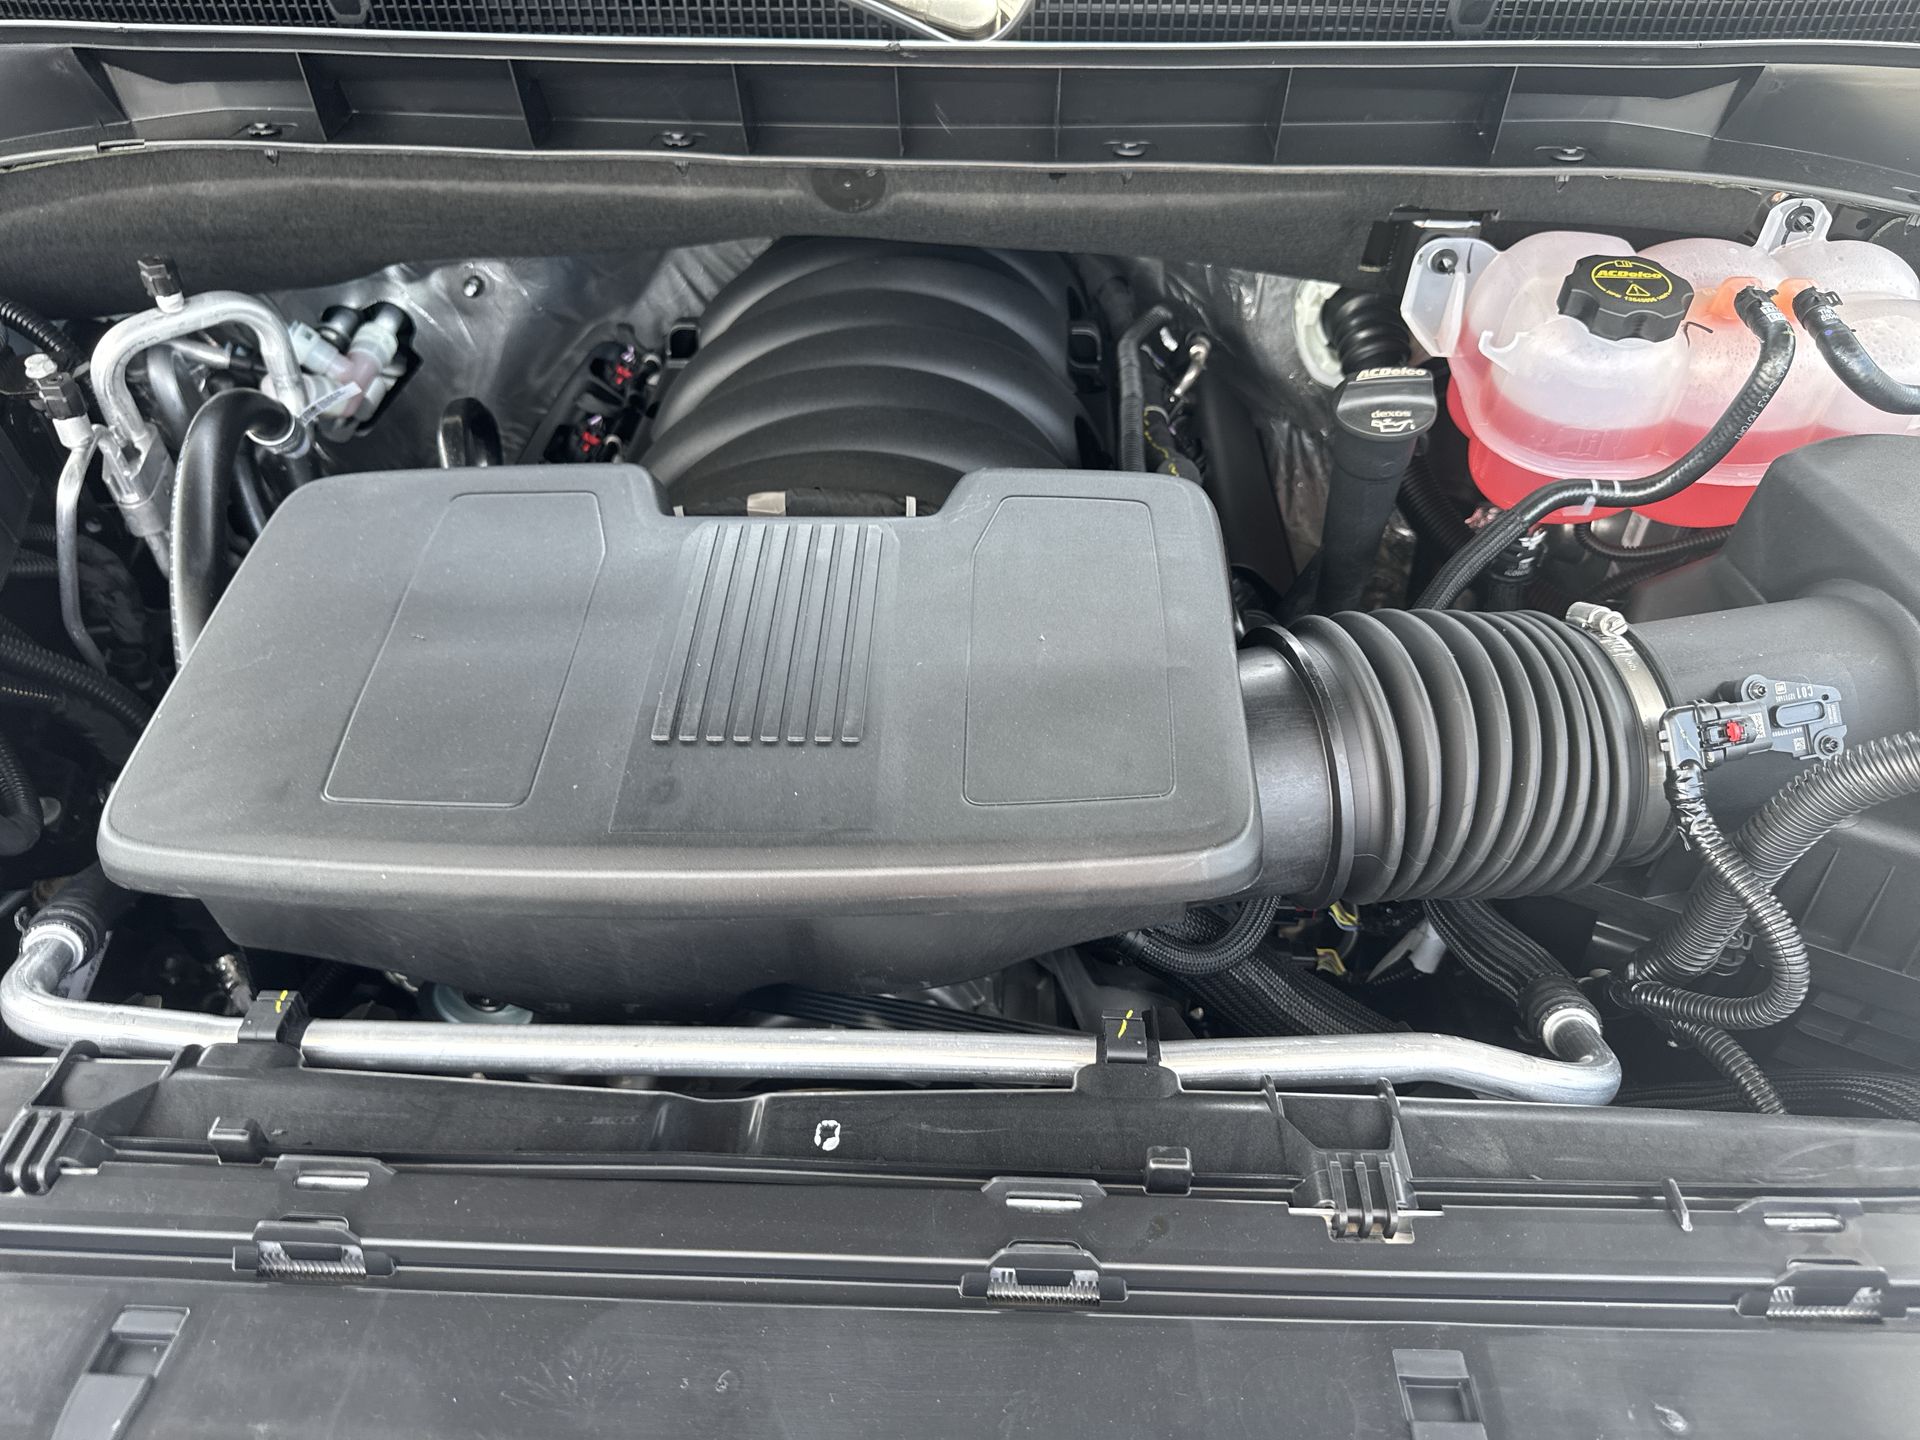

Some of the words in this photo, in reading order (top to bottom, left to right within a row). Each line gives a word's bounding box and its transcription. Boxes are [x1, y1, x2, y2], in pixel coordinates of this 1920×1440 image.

[1595, 269, 1662, 280] ACDelco
[1356, 367, 1428, 382] ACDelco
[1370, 409, 1412, 418] dexos
